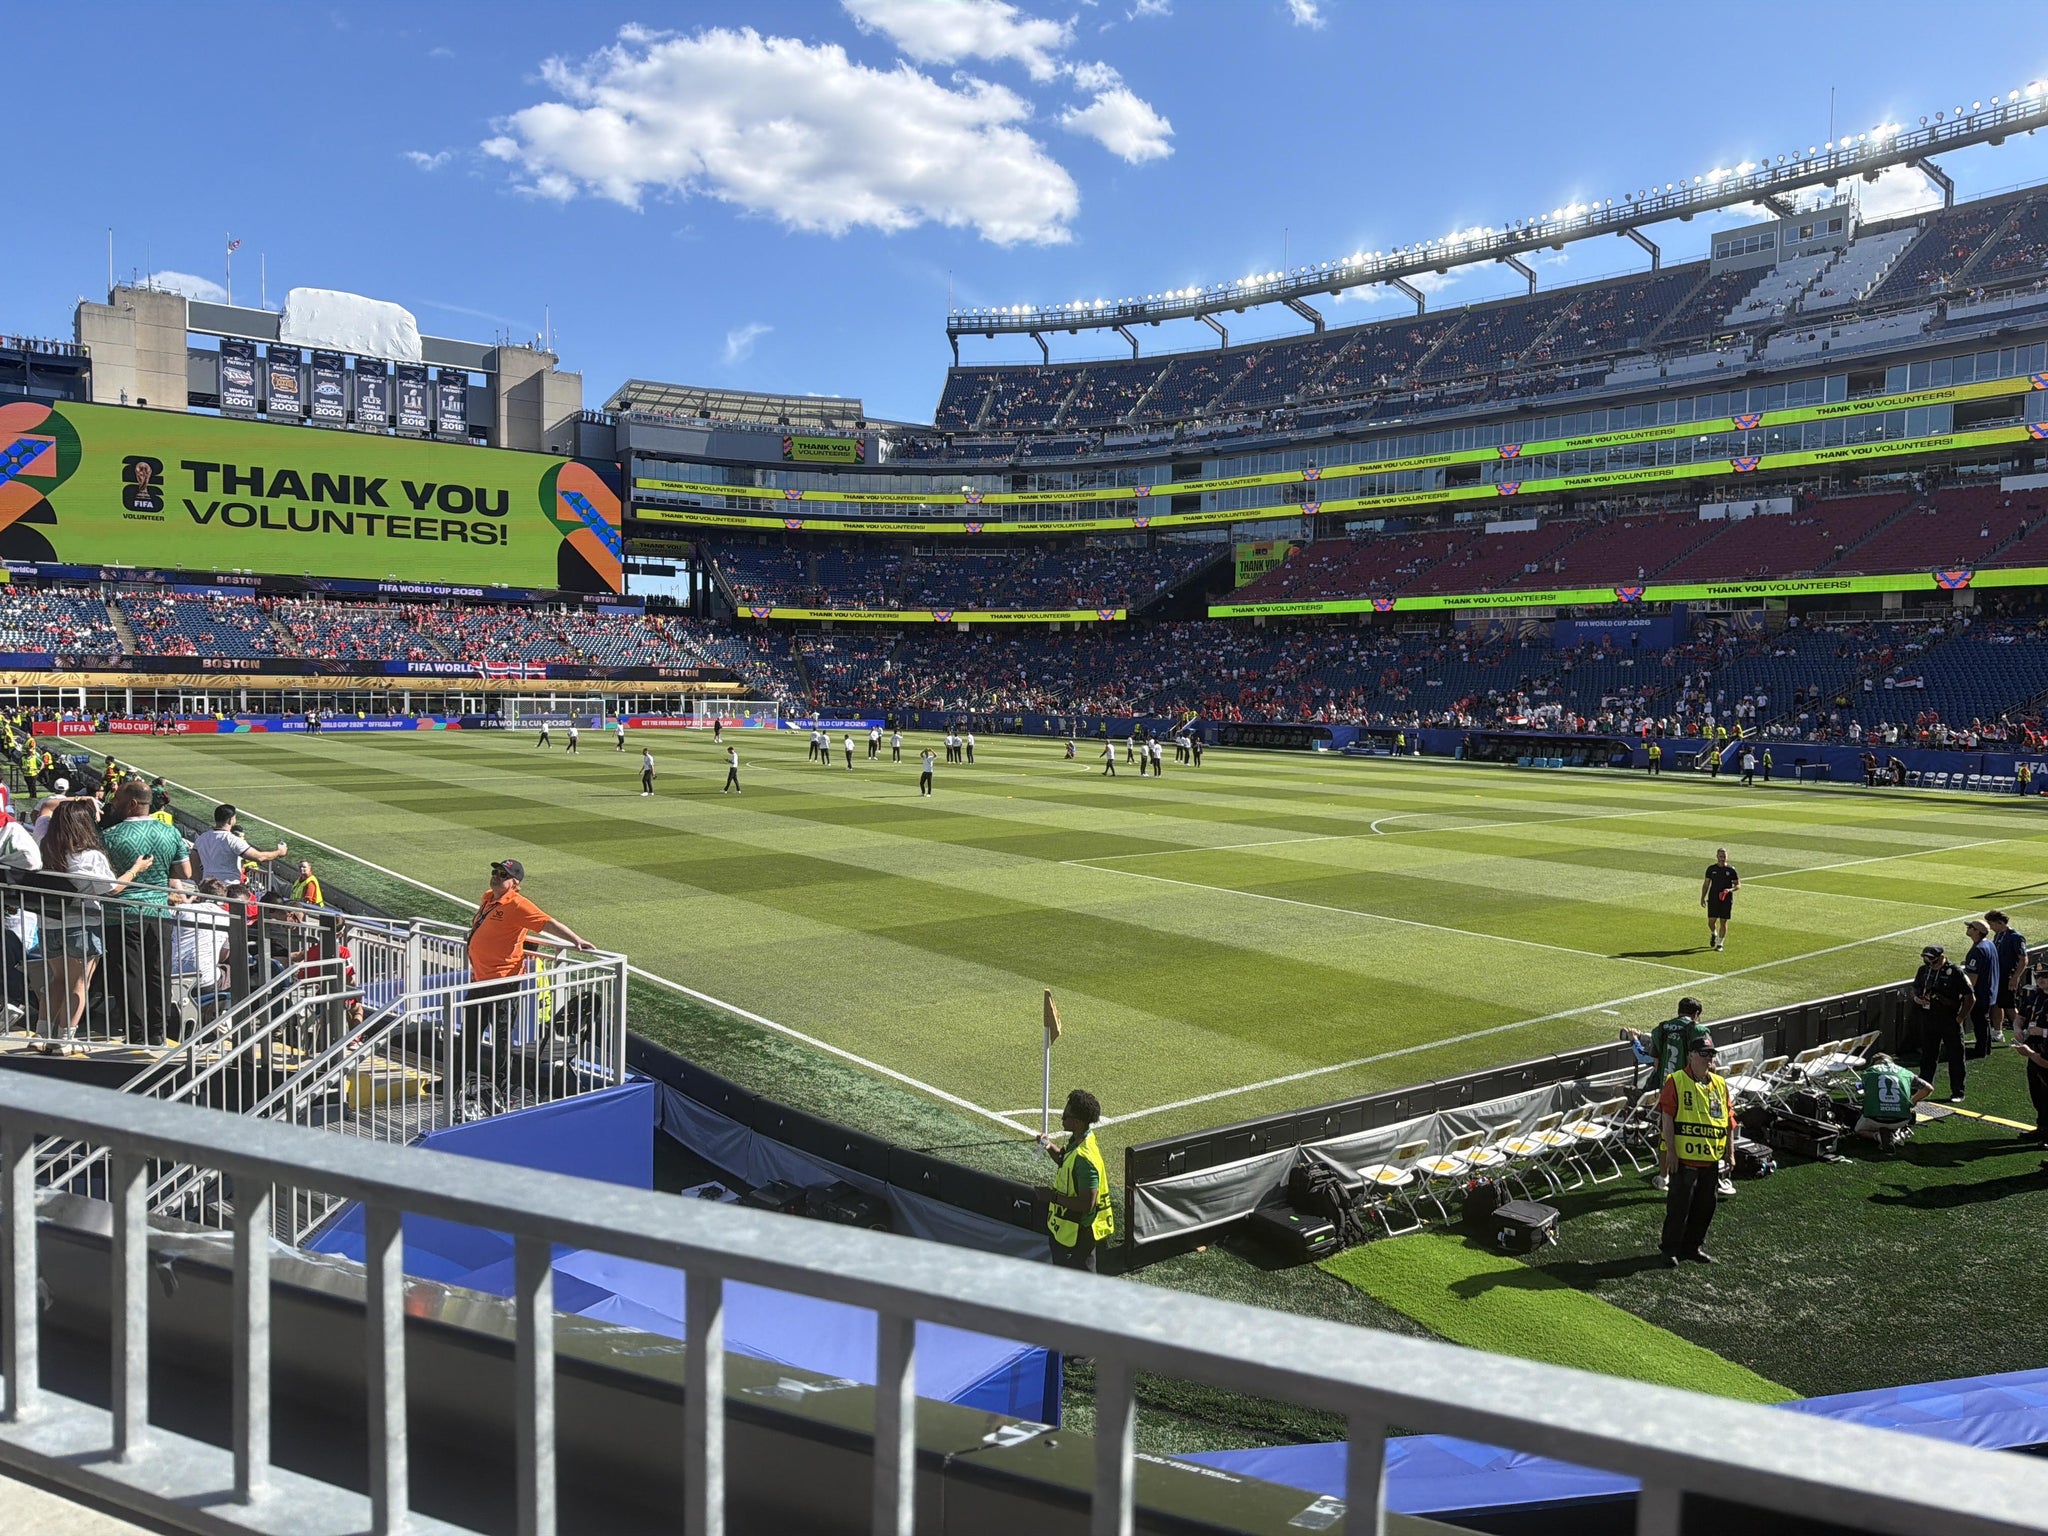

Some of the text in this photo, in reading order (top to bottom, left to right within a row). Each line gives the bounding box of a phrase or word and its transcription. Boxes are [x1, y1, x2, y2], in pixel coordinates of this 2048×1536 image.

[226, 397, 253, 407] 2001
[270, 402, 299, 412] 2003
[1816, 389, 1955, 415] THANK YOU VOLUNTEERS!
[315, 408, 343, 417] 2004
[402, 418, 425, 427] 2016
[442, 422, 465, 431] 2018
[1565, 427, 1676, 447] THANK YOU VOLUNTEERS!
[1814, 437, 1953, 460] THANK YOU VOLUNTEERS!
[1358, 455, 1451, 471] THANK YOU VOLUNTEERS!
[1564, 468, 1674, 486] THANK YOU VOLUNTEERS!
[181, 460, 509, 517] THANK YOU
[1397, 492, 1450, 503] VOLUNTEERS!
[134, 500, 153, 509] FIFA
[123, 513, 165, 522] VOLUNTEER
[182, 499, 508, 546] VOLUNTEERS!
[1240, 560, 1264, 572] THANK
[216, 575, 262, 585] BOSTON
[378, 584, 483, 596] FIFA WORLD CUP 2026
[1706, 580, 1851, 594] THANK YOU VOLUNTEERS!
[583, 595, 618, 604] BOSTON
[1443, 597, 1472, 605] THANK
[1491, 594, 1556, 603] VOLUNTEERS!
[203, 658, 261, 669] BOSTON
[408, 662, 474, 673] FIFA WORLD
[659, 668, 699, 677] BOSTON
[133, 723, 149, 731] CUP
